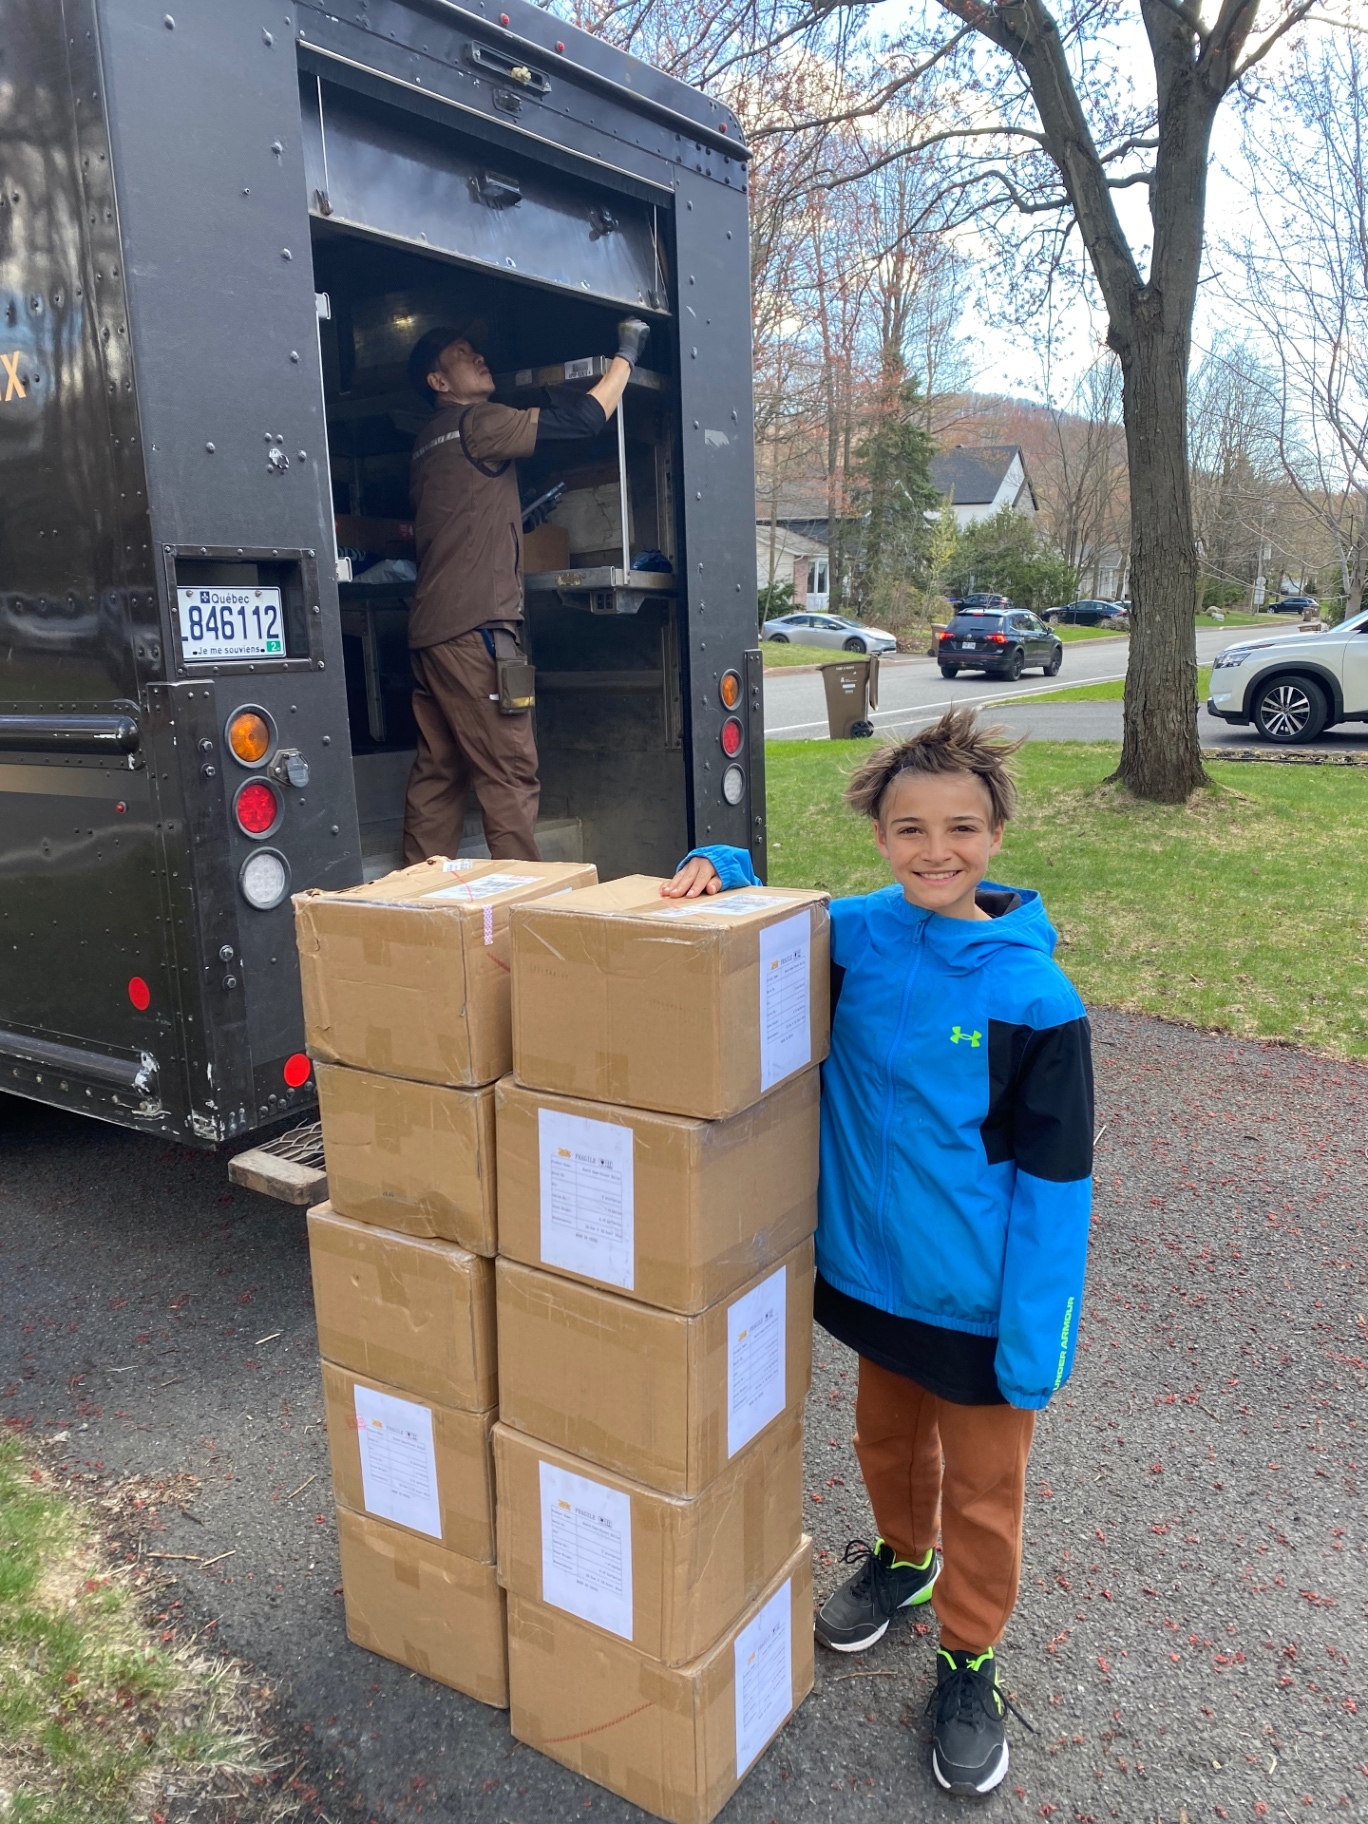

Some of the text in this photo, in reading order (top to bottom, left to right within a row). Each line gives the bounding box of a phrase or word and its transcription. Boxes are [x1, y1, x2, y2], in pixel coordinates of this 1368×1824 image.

[0, 351, 26, 401] X
[212, 593, 250, 604] Québec
[199, 646, 208, 655] Je
[225, 645, 260, 653] souviens
[1052, 1296, 1075, 1391] UNDER ARMOUR
